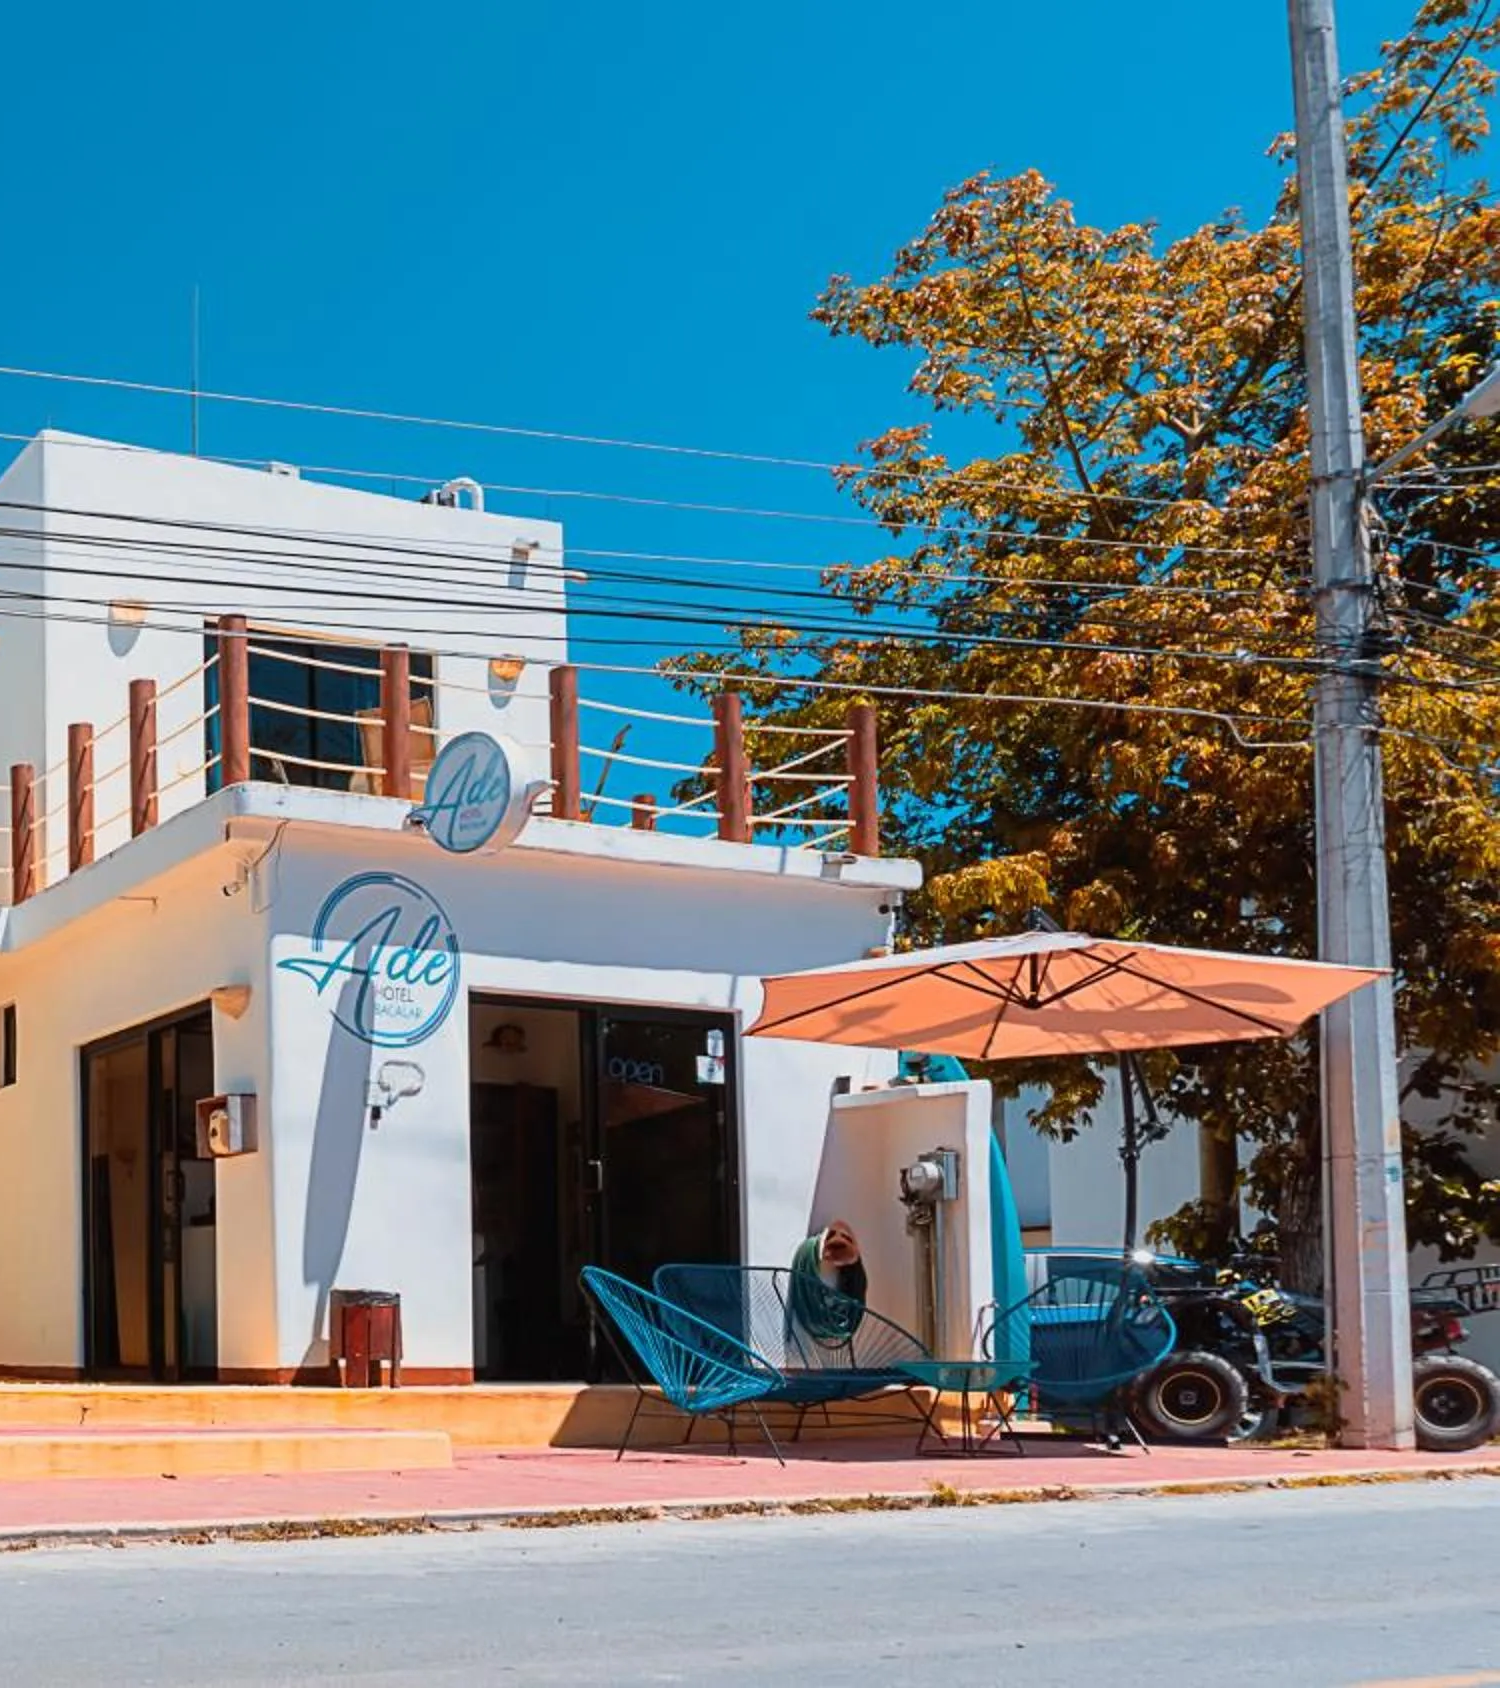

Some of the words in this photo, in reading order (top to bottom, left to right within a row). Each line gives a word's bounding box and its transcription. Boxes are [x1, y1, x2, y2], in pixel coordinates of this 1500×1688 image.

[407, 753, 502, 844] Ade
[277, 906, 450, 1034] Ade
[609, 1056, 664, 1084] open
